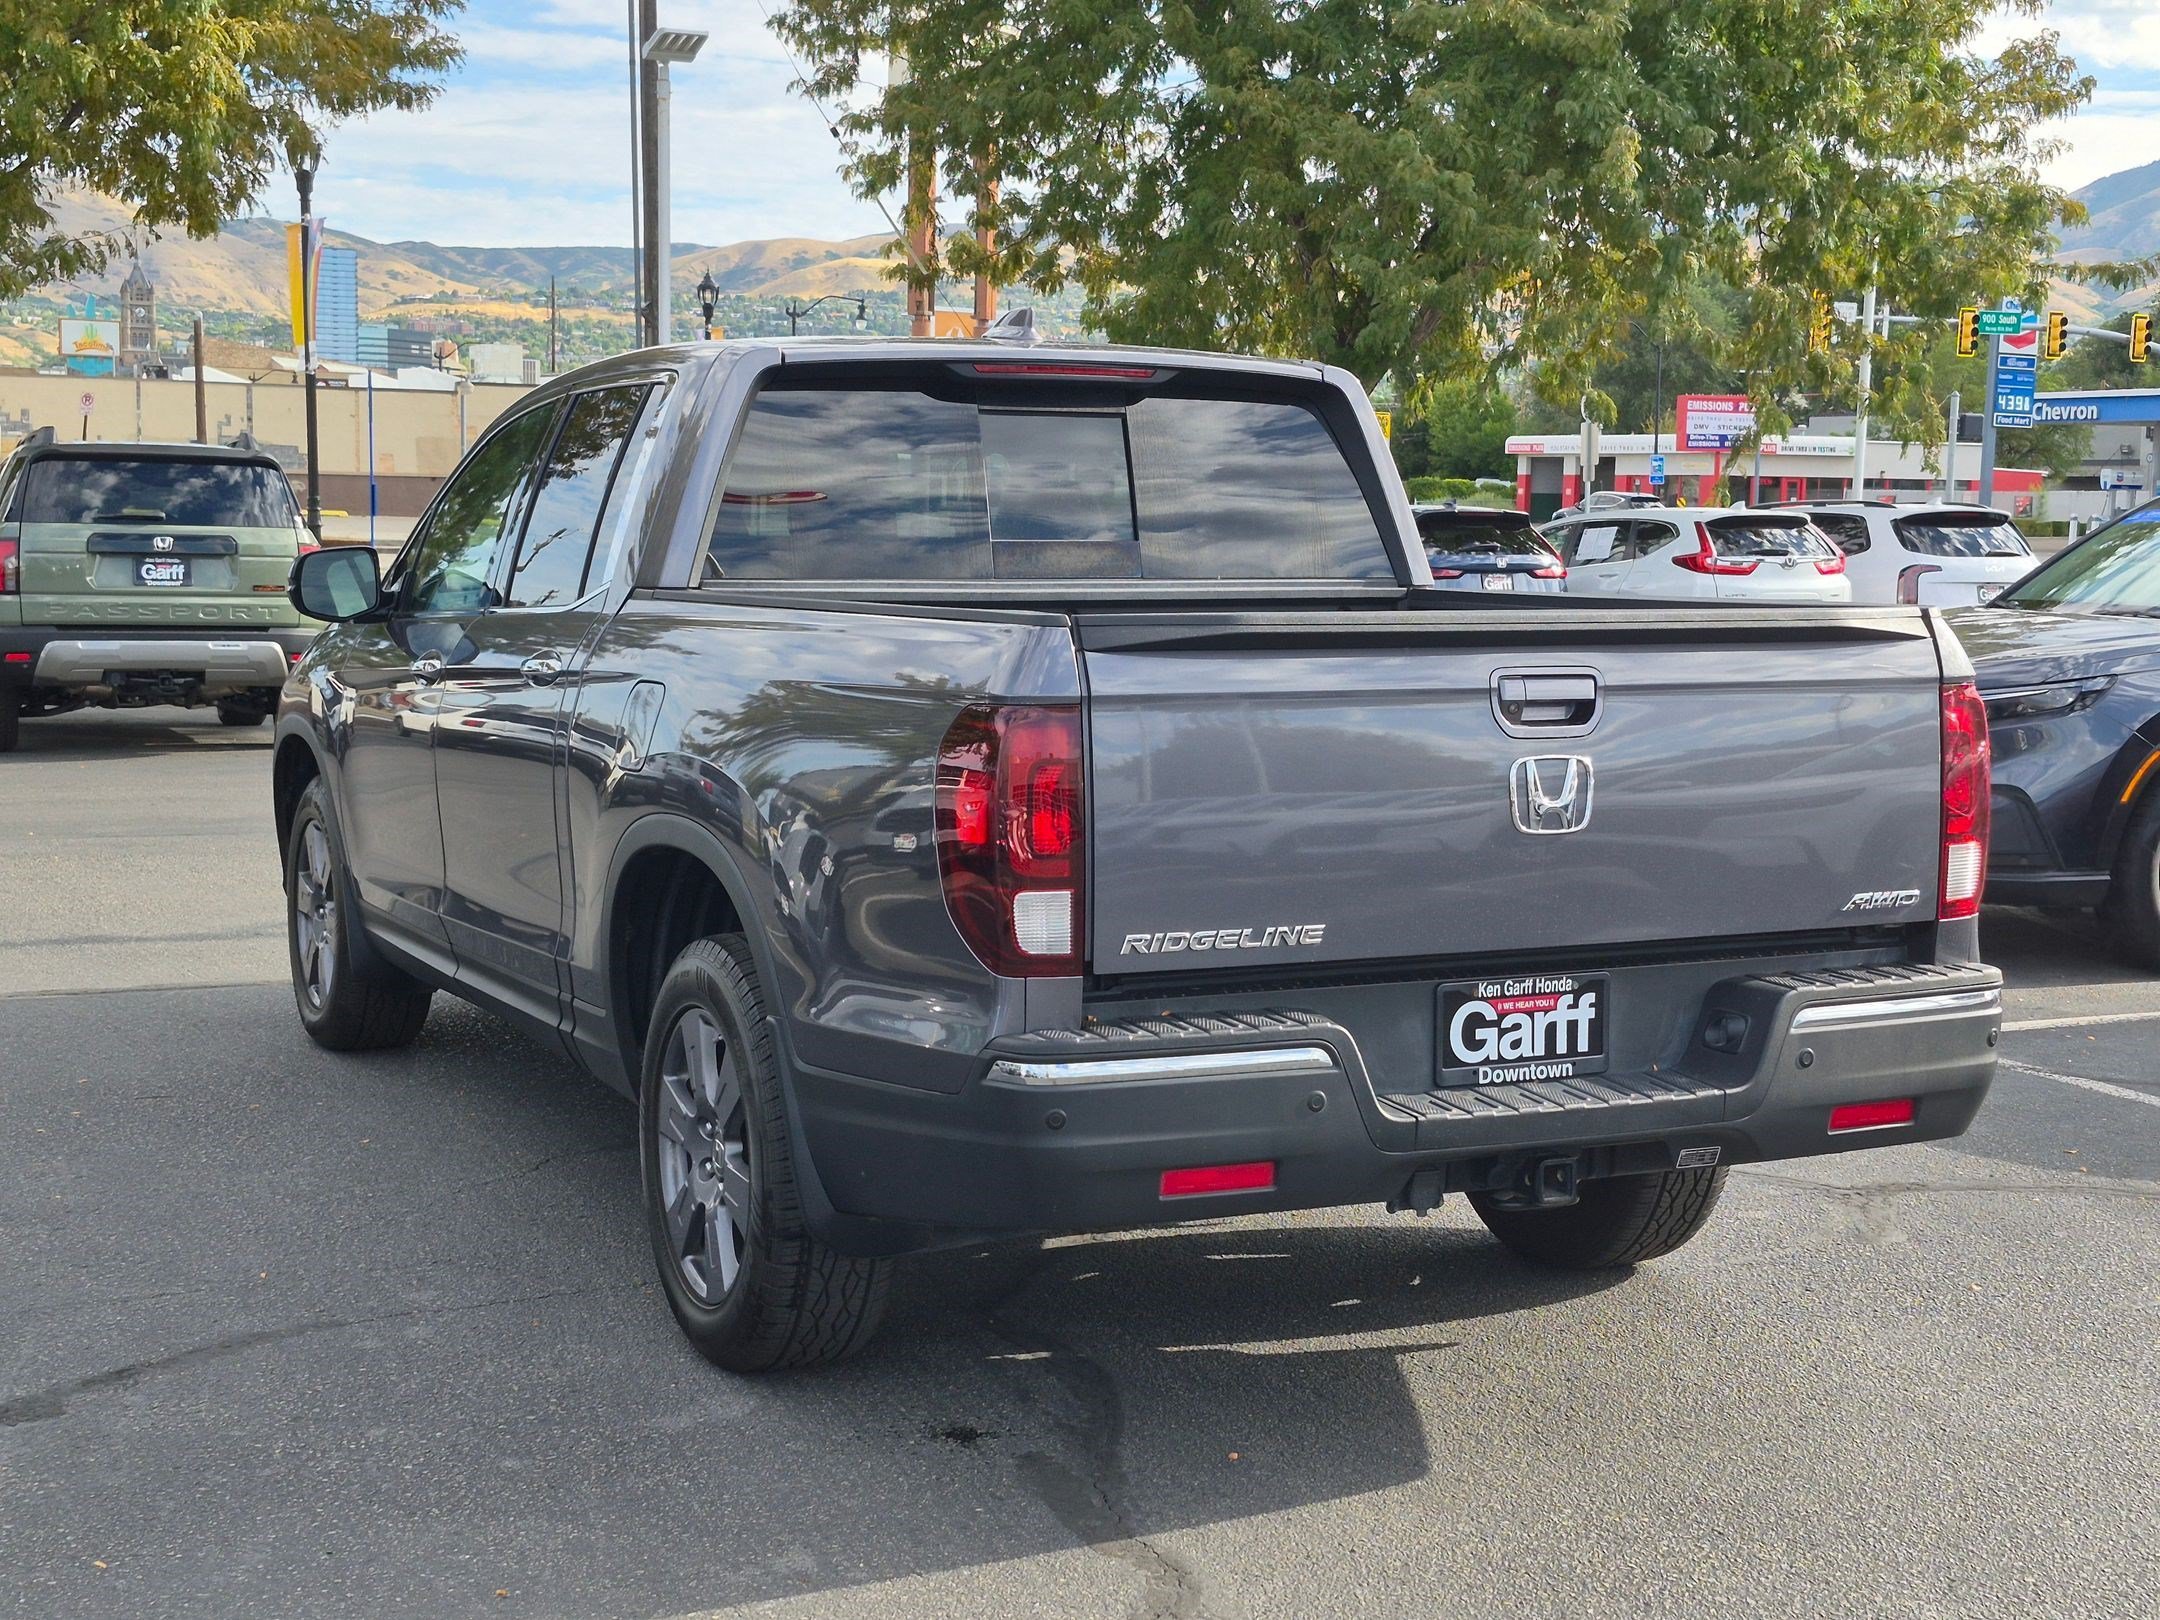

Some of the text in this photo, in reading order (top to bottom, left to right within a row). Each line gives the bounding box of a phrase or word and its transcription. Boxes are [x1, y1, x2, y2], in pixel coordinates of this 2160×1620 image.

[1982, 314, 2017, 324] 900 South
[1687, 400, 1733, 412] EMISSIONS
[2033, 402, 2097, 420] Chevron
[1997, 416, 2013, 424] Food
[1760, 444, 1776, 452] PLUS
[141, 564, 184, 579] Garff
[44, 603, 280, 620] PASSPORT
[1841, 889, 1920, 911] AWD
[1120, 924, 1326, 955] RIDGELINE
[1478, 976, 1572, 998] Ken Garff Honda
[1503, 999, 1550, 1010] WE HEAR YOU
[1450, 992, 1595, 1064] Garff
[1478, 1063, 1573, 1085] Downtown
